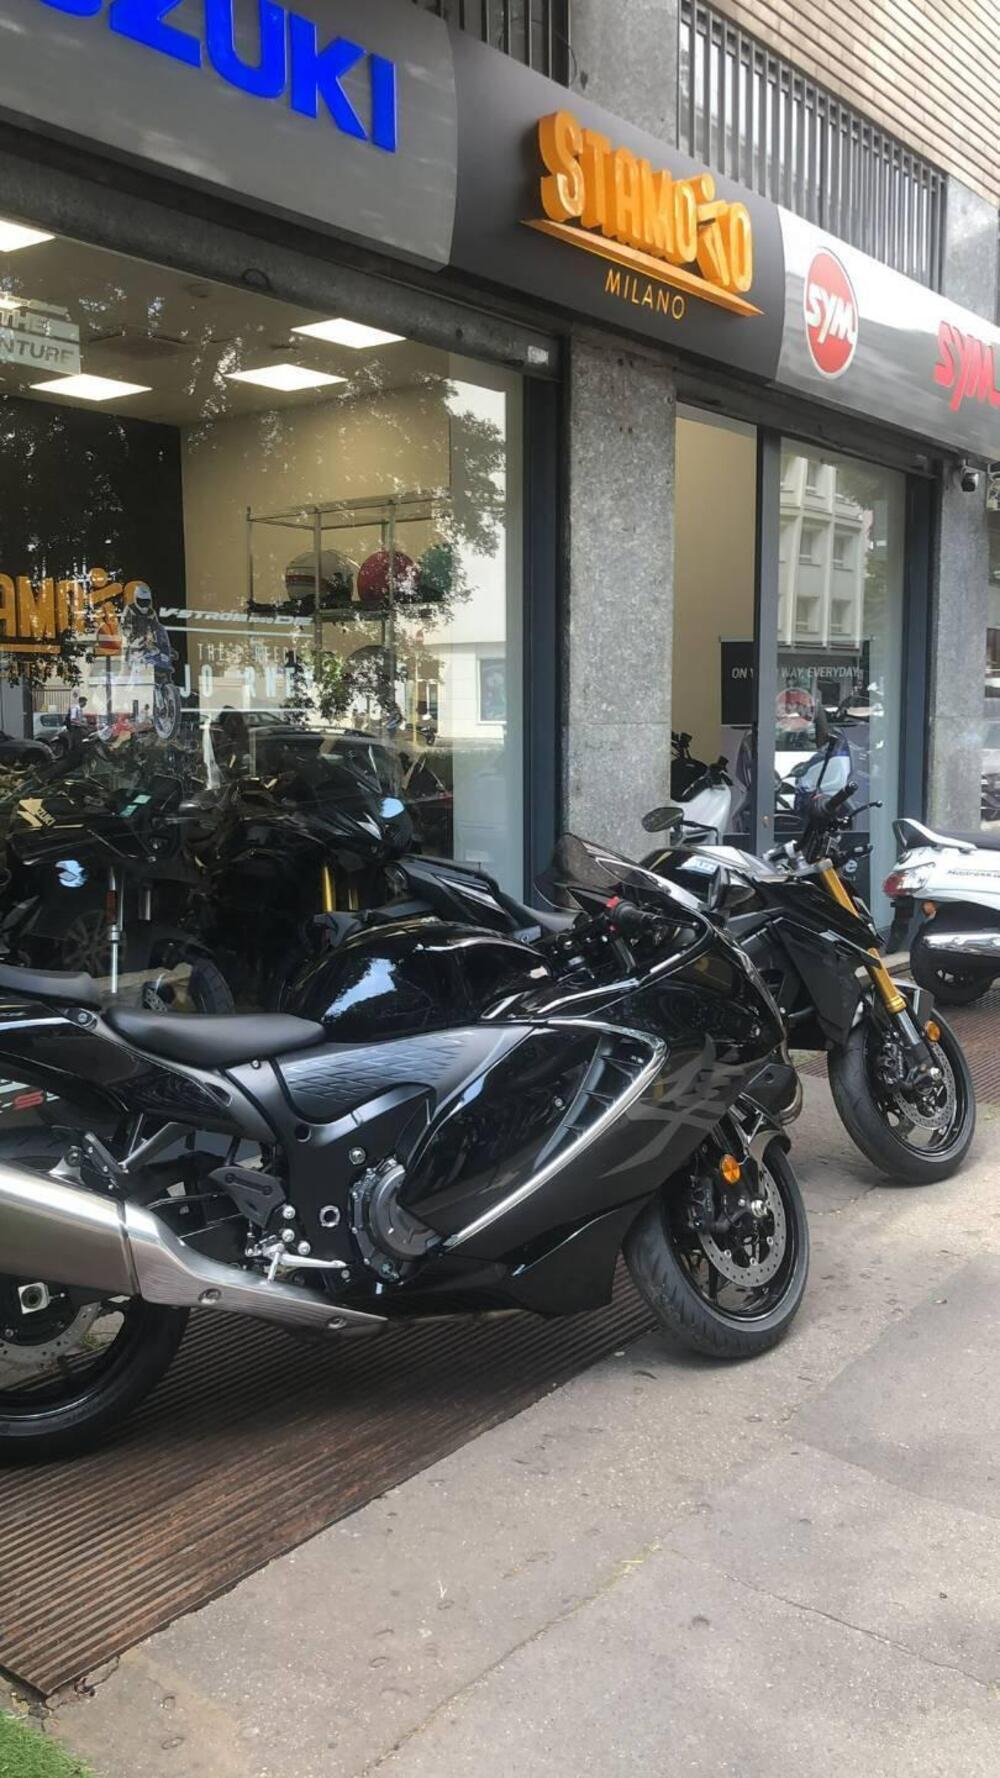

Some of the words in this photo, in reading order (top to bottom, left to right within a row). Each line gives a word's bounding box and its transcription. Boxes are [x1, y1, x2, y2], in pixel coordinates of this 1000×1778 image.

[40, 0, 397, 153] ZUKI
[604, 268, 686, 320] MILANO
[805, 282, 858, 345] SYM
[933, 320, 1000, 413] SYM
[731, 667, 746, 679] ON
